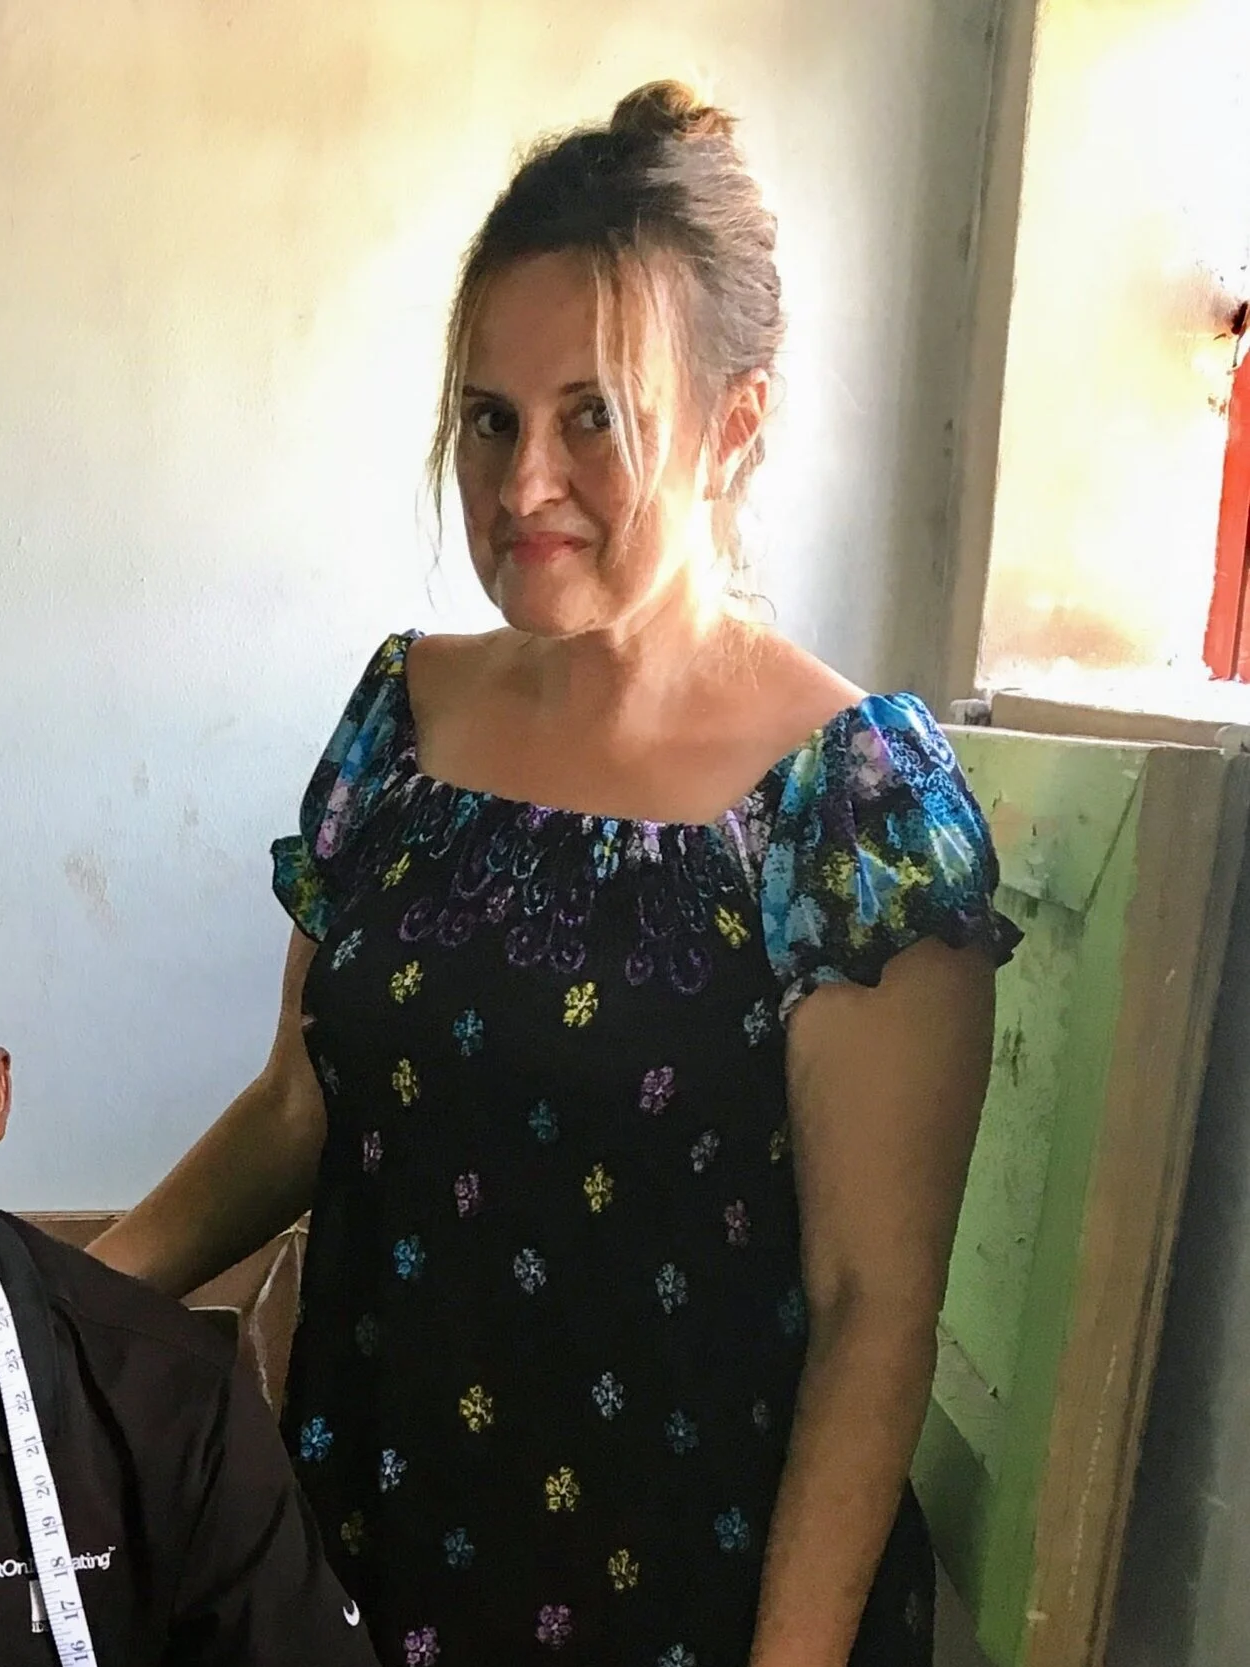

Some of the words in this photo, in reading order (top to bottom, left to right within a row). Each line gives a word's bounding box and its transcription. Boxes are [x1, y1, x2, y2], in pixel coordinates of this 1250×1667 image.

[42, 1516, 59, 1537] 19
[51, 1556, 69, 1578] 18
[70, 1551, 111, 1571] ating
[60, 1600, 79, 1620] 17
[70, 1640, 88, 1661] 16
